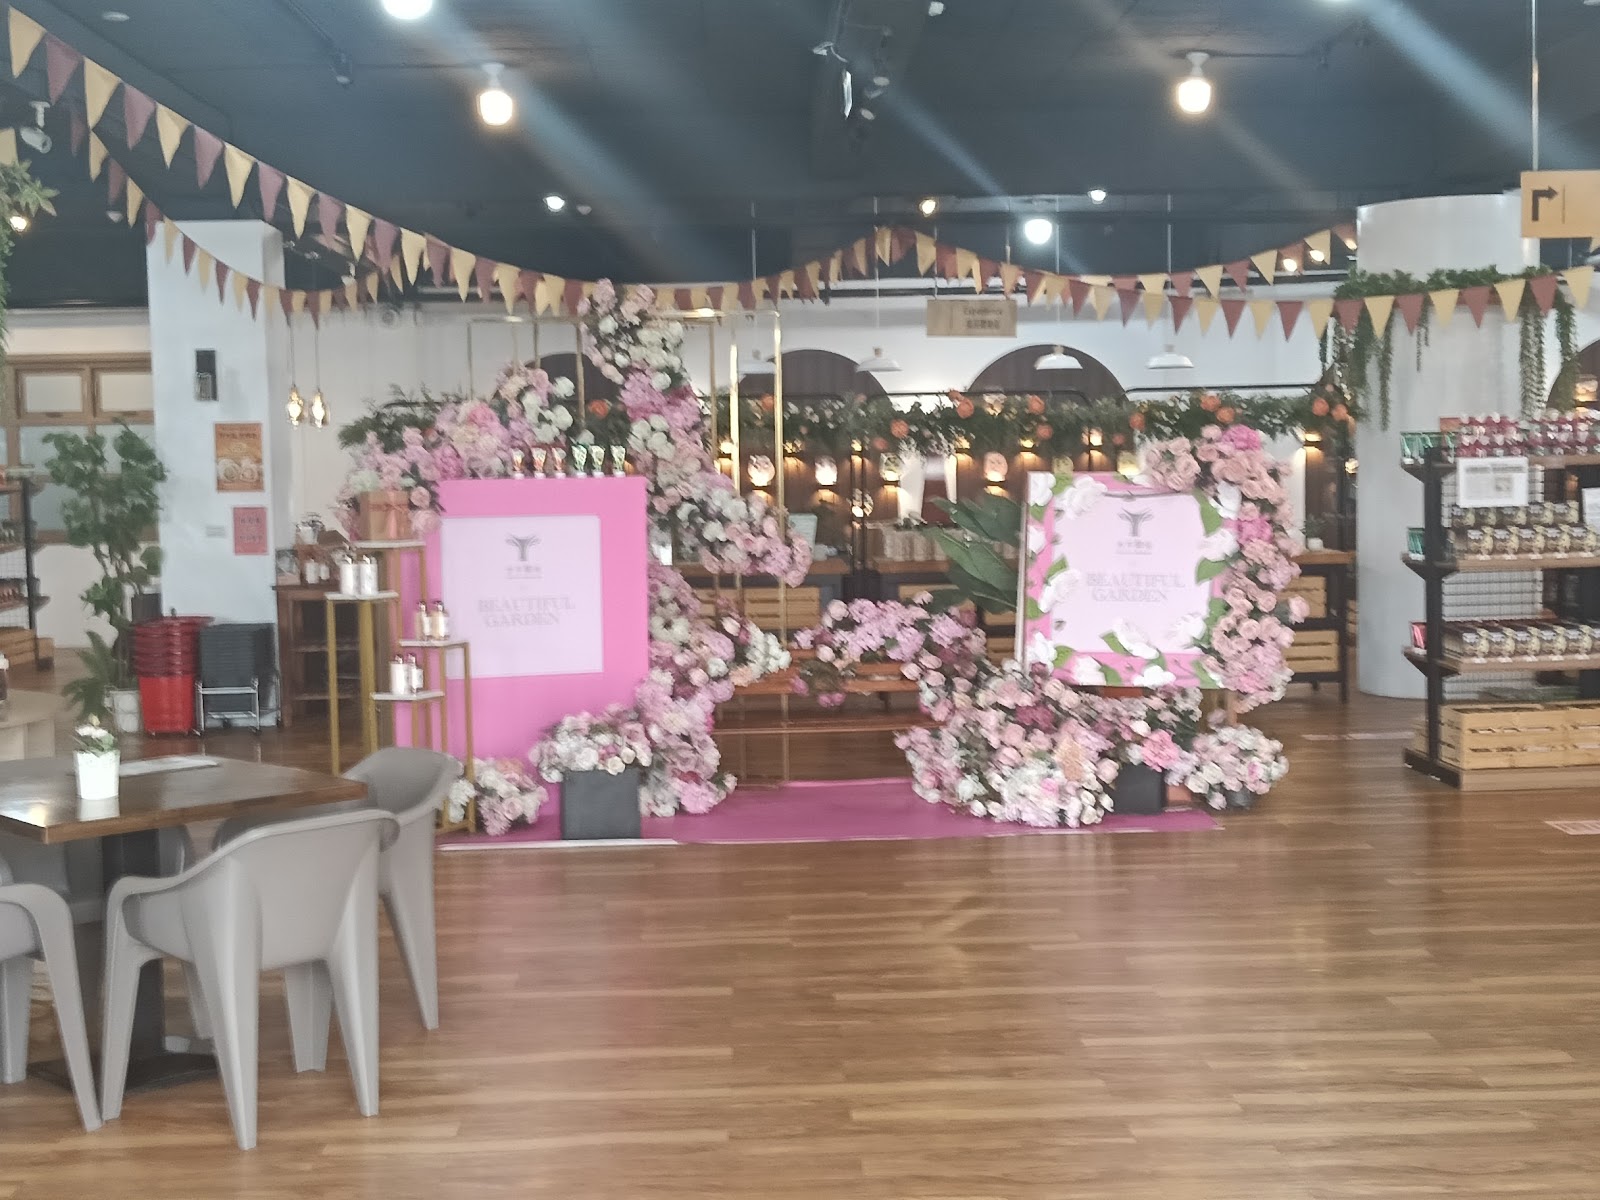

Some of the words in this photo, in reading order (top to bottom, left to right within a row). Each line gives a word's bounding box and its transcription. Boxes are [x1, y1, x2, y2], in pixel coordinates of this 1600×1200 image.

[1086, 573, 1186, 588] BEAUTIFUL
[1092, 588, 1169, 602] GARDEN
[478, 597, 576, 612] BEAUTIFUL
[485, 612, 560, 627] GARDEN
